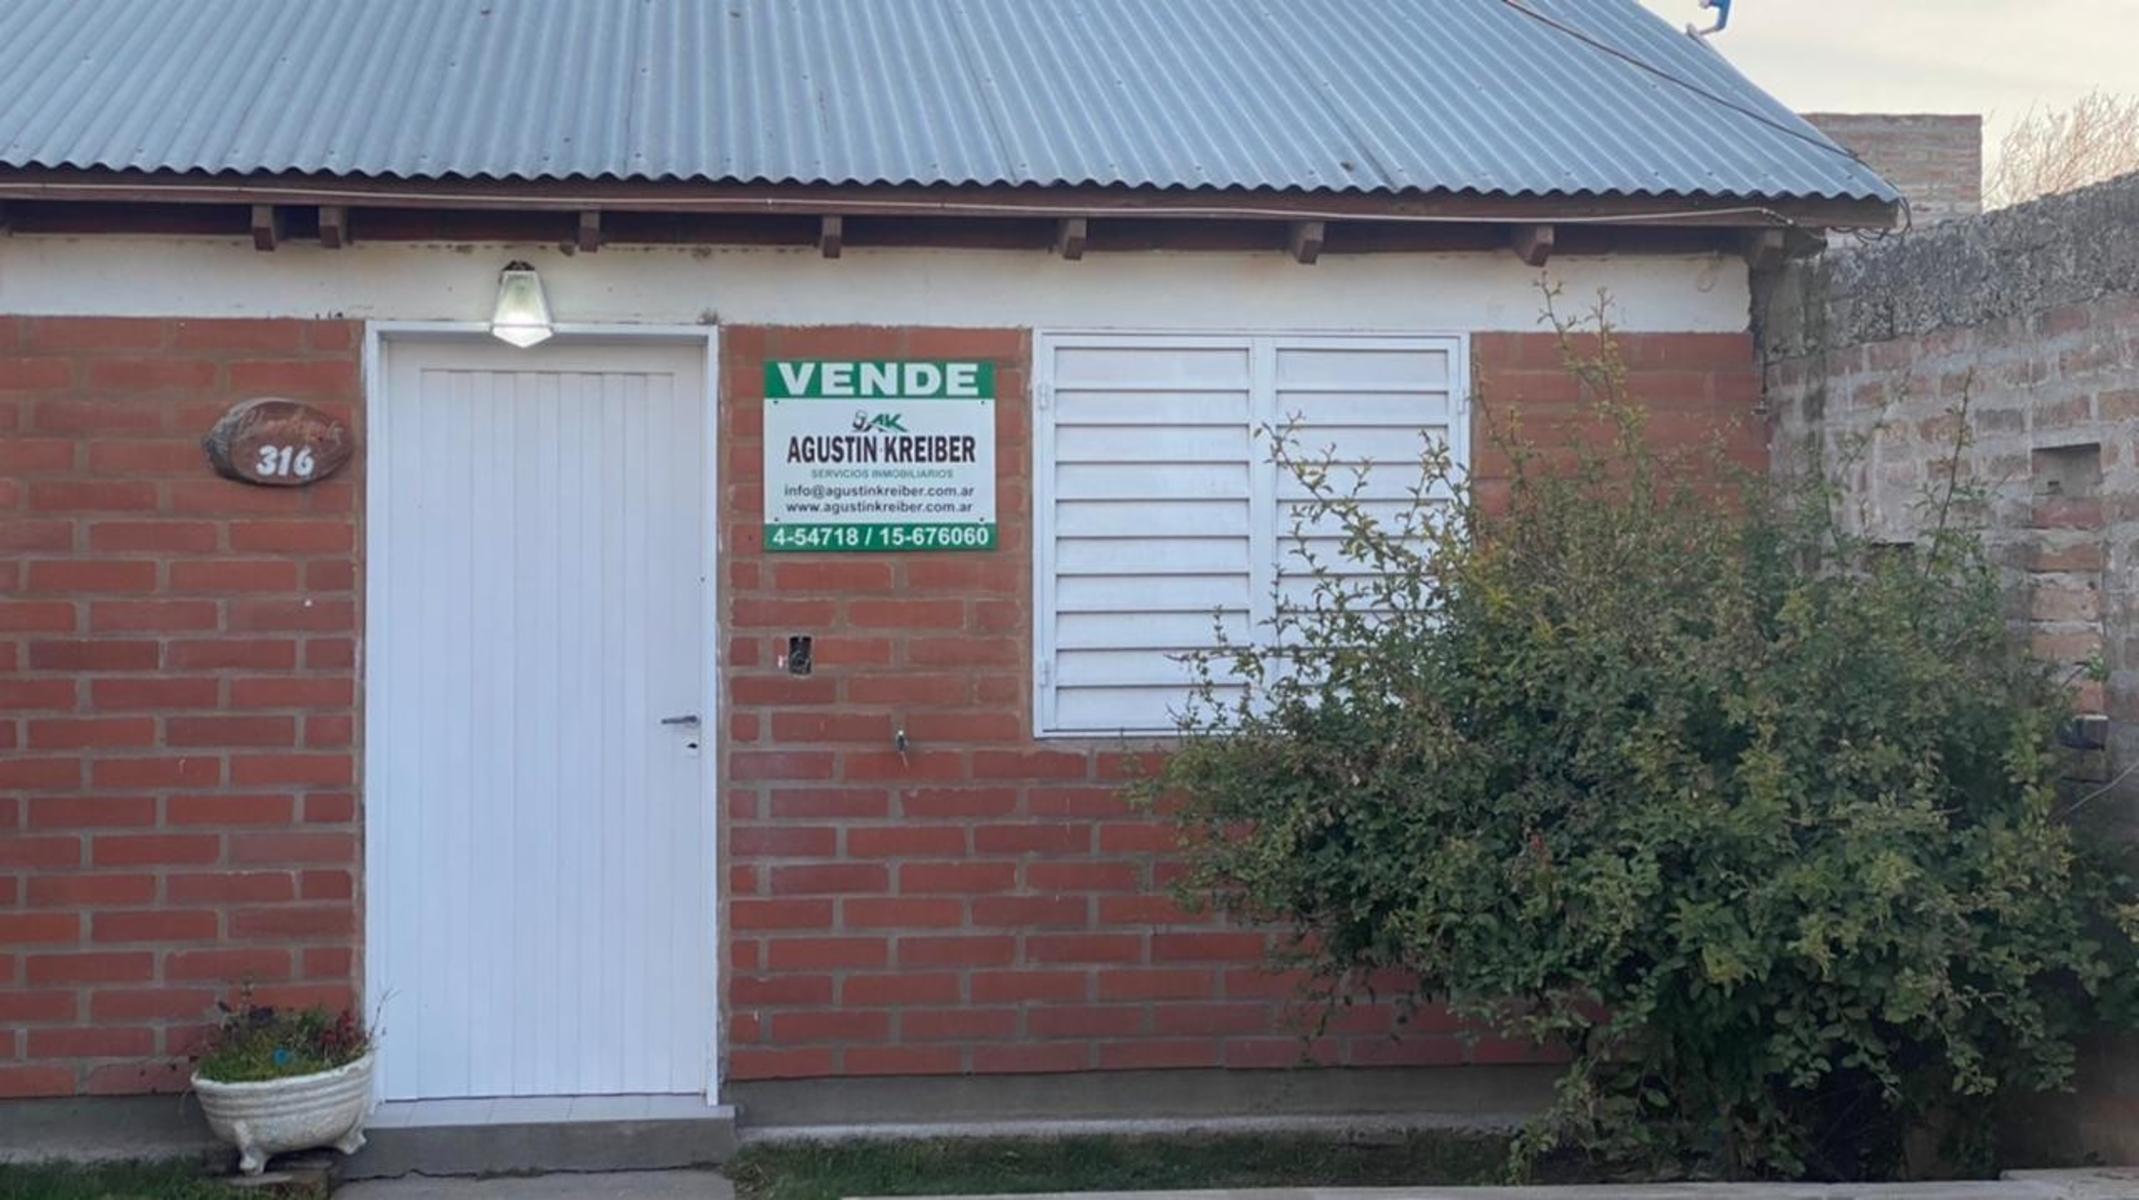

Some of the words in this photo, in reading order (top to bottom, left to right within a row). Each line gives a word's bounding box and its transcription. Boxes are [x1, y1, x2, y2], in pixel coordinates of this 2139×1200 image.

[777, 362, 979, 396] VENDE
[787, 436, 877, 463] AGUSTIN
[884, 436, 976, 463] KREIBER
[256, 445, 315, 476] 316
[811, 469, 869, 479] SERVICIOS
[872, 469, 953, 479] INMOBILIARIOS
[784, 484, 974, 498] info@agustinkreiber.com.ar
[786, 501, 973, 514] www.agustinkreiber.com.ar
[773, 527, 858, 546] 4-54718
[864, 527, 874, 546] /
[879, 527, 989, 546] 15-676060
